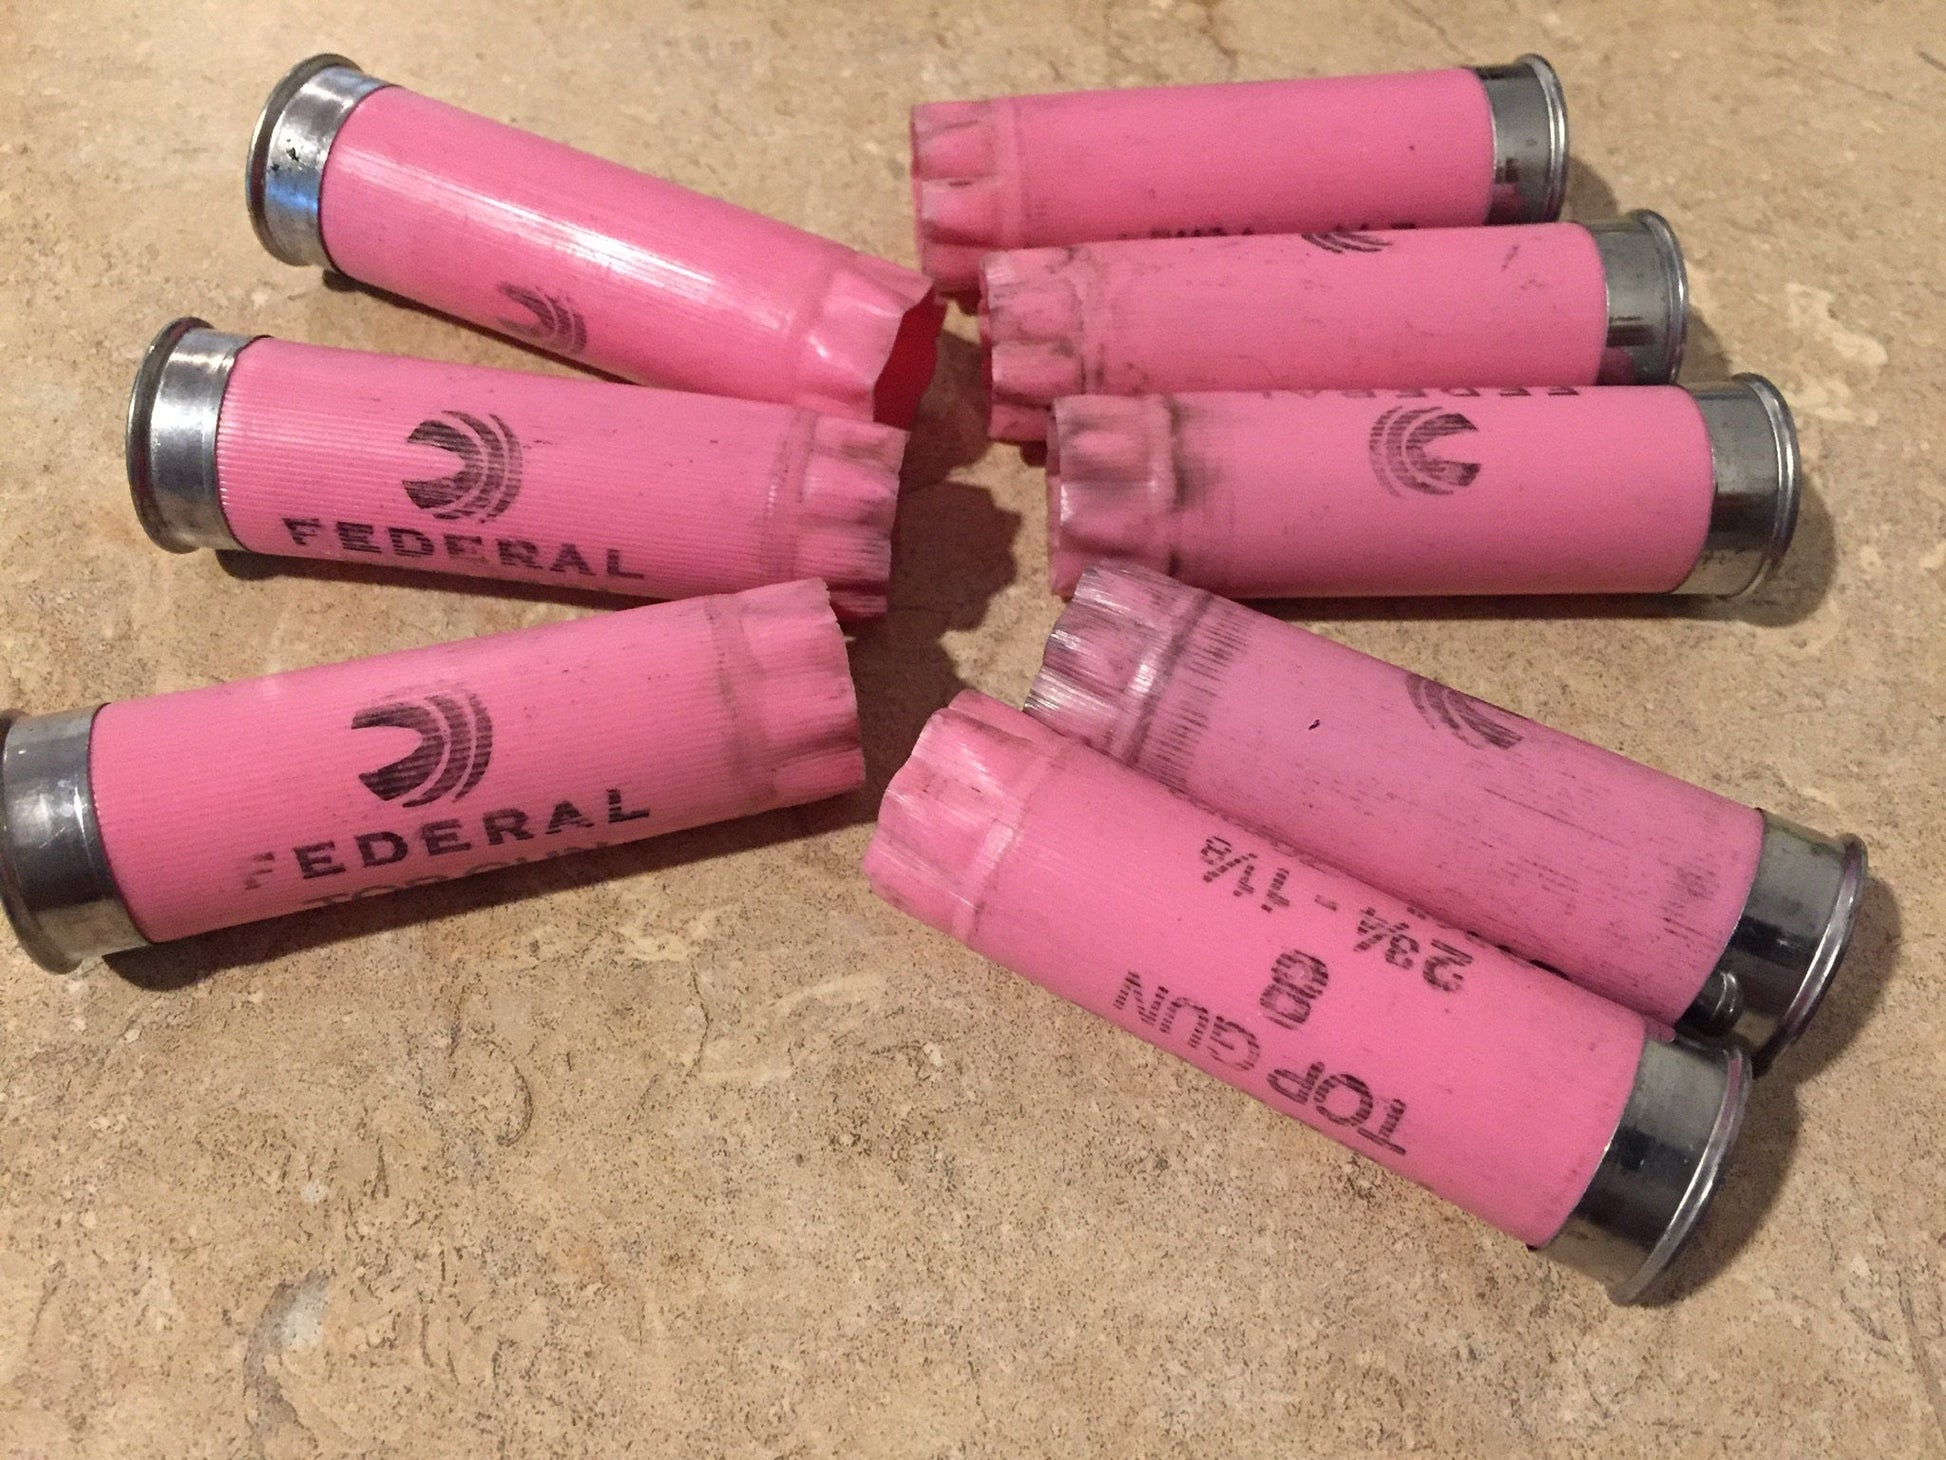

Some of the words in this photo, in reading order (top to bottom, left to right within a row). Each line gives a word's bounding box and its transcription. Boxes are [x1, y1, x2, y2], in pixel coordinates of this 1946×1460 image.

[282, 517, 645, 580] FEDERAL
[1112, 970, 1261, 1073] GUN
[1259, 947, 1329, 1031] 8
[1266, 1060, 1407, 1155] TOP
